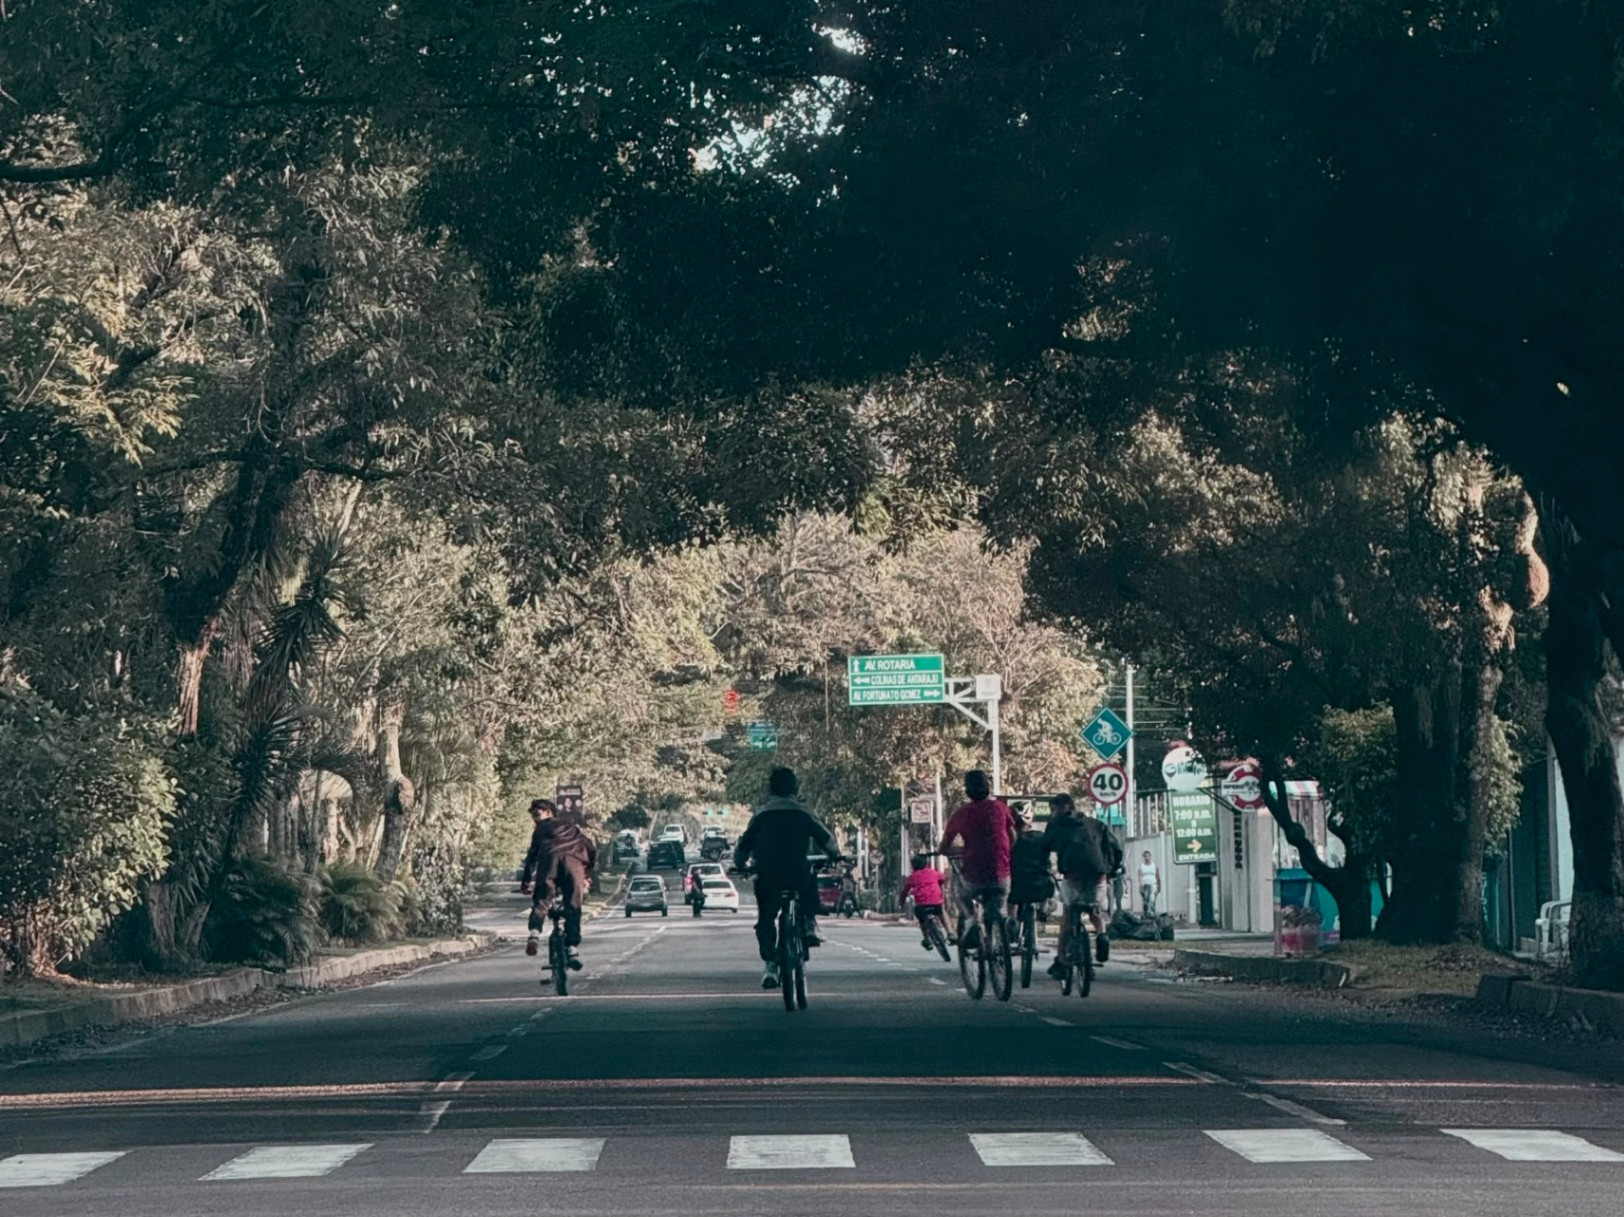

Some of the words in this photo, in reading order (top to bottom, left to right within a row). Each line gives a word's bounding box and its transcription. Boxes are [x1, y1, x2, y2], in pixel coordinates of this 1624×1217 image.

[877, 659, 916, 671] ROTARIA
[871, 674, 897, 686] COLINAS
[897, 674, 906, 685] DE
[862, 689, 900, 701] FORTUNATO
[1093, 773, 1123, 791] 40
[1172, 795, 1211, 807] HORARIO
[1174, 809, 1193, 821] 7:00
[1176, 827, 1197, 838] 12:00
[1178, 852, 1216, 861] ENTRADA
